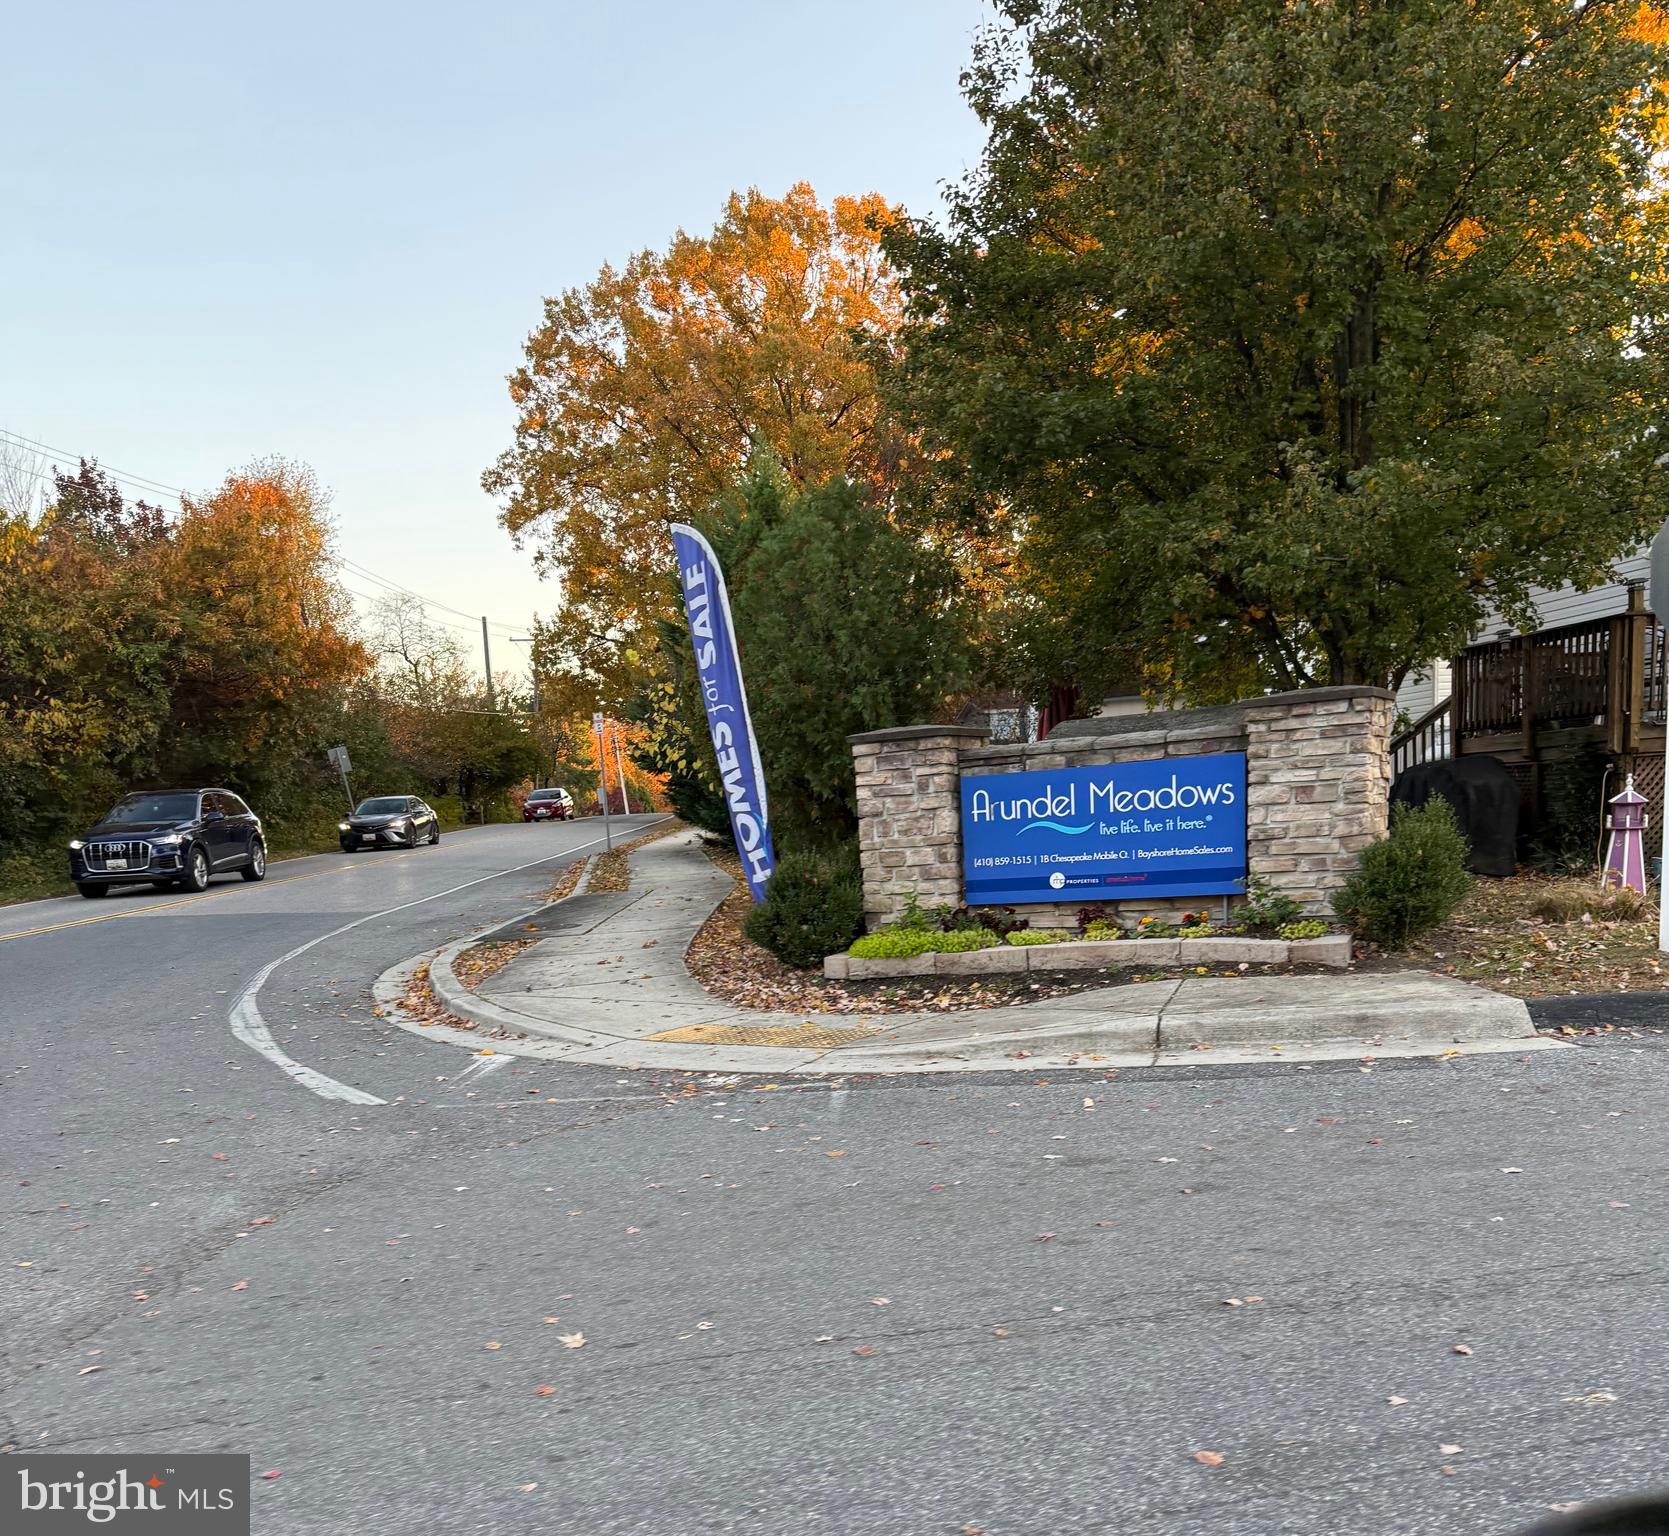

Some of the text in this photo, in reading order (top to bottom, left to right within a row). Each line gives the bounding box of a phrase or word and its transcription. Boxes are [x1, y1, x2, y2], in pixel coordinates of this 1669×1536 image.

[686, 560, 773, 884] HOMES for SALE
[971, 774, 1235, 823] Arundel Meadows
[1100, 815, 1207, 835] live life. live it here.
[974, 857, 994, 868] (410)
[995, 855, 1032, 867] 859-1515
[1050, 851, 1092, 864] Chesapeake
[1093, 848, 1119, 861] Mobile
[1137, 844, 1233, 860] BayshoreHomeSales.com
